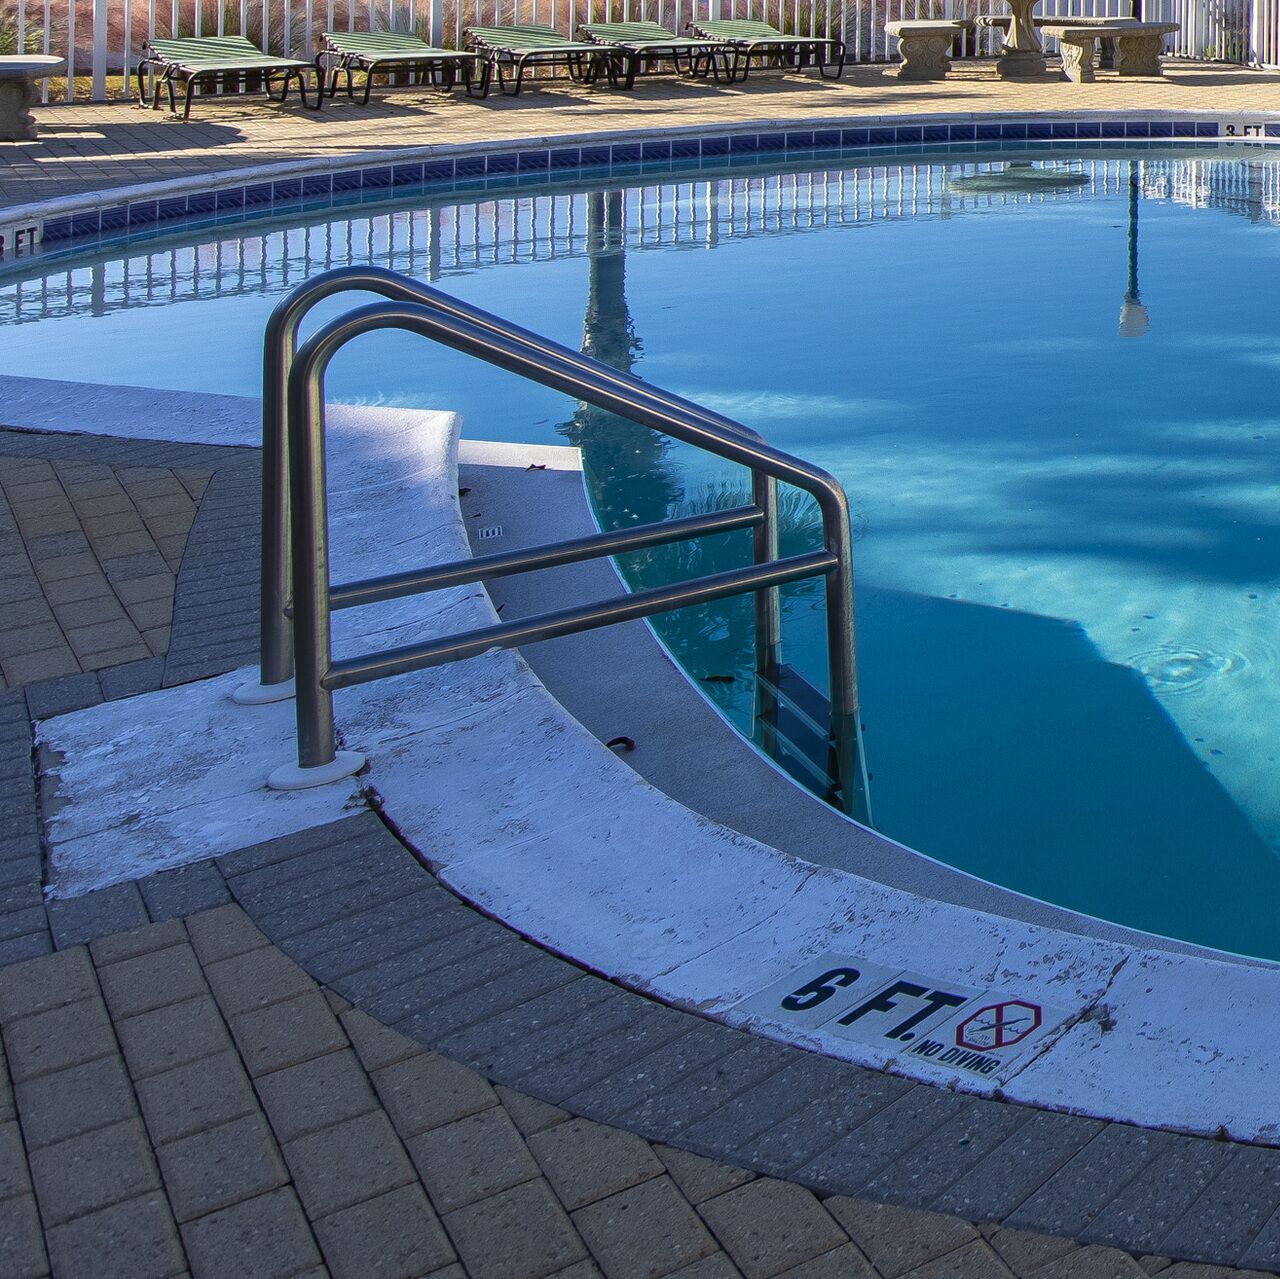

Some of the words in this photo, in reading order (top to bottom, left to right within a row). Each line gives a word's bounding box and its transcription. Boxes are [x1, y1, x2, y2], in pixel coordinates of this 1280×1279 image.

[1226, 125, 1235, 137] 3
[1244, 125, 1262, 137] FT
[15, 226, 38, 249] FT
[781, 967, 861, 1011] 6
[836, 980, 969, 1041] FT.
[911, 1039, 944, 1056] NO
[938, 1047, 1001, 1074] DIVING
